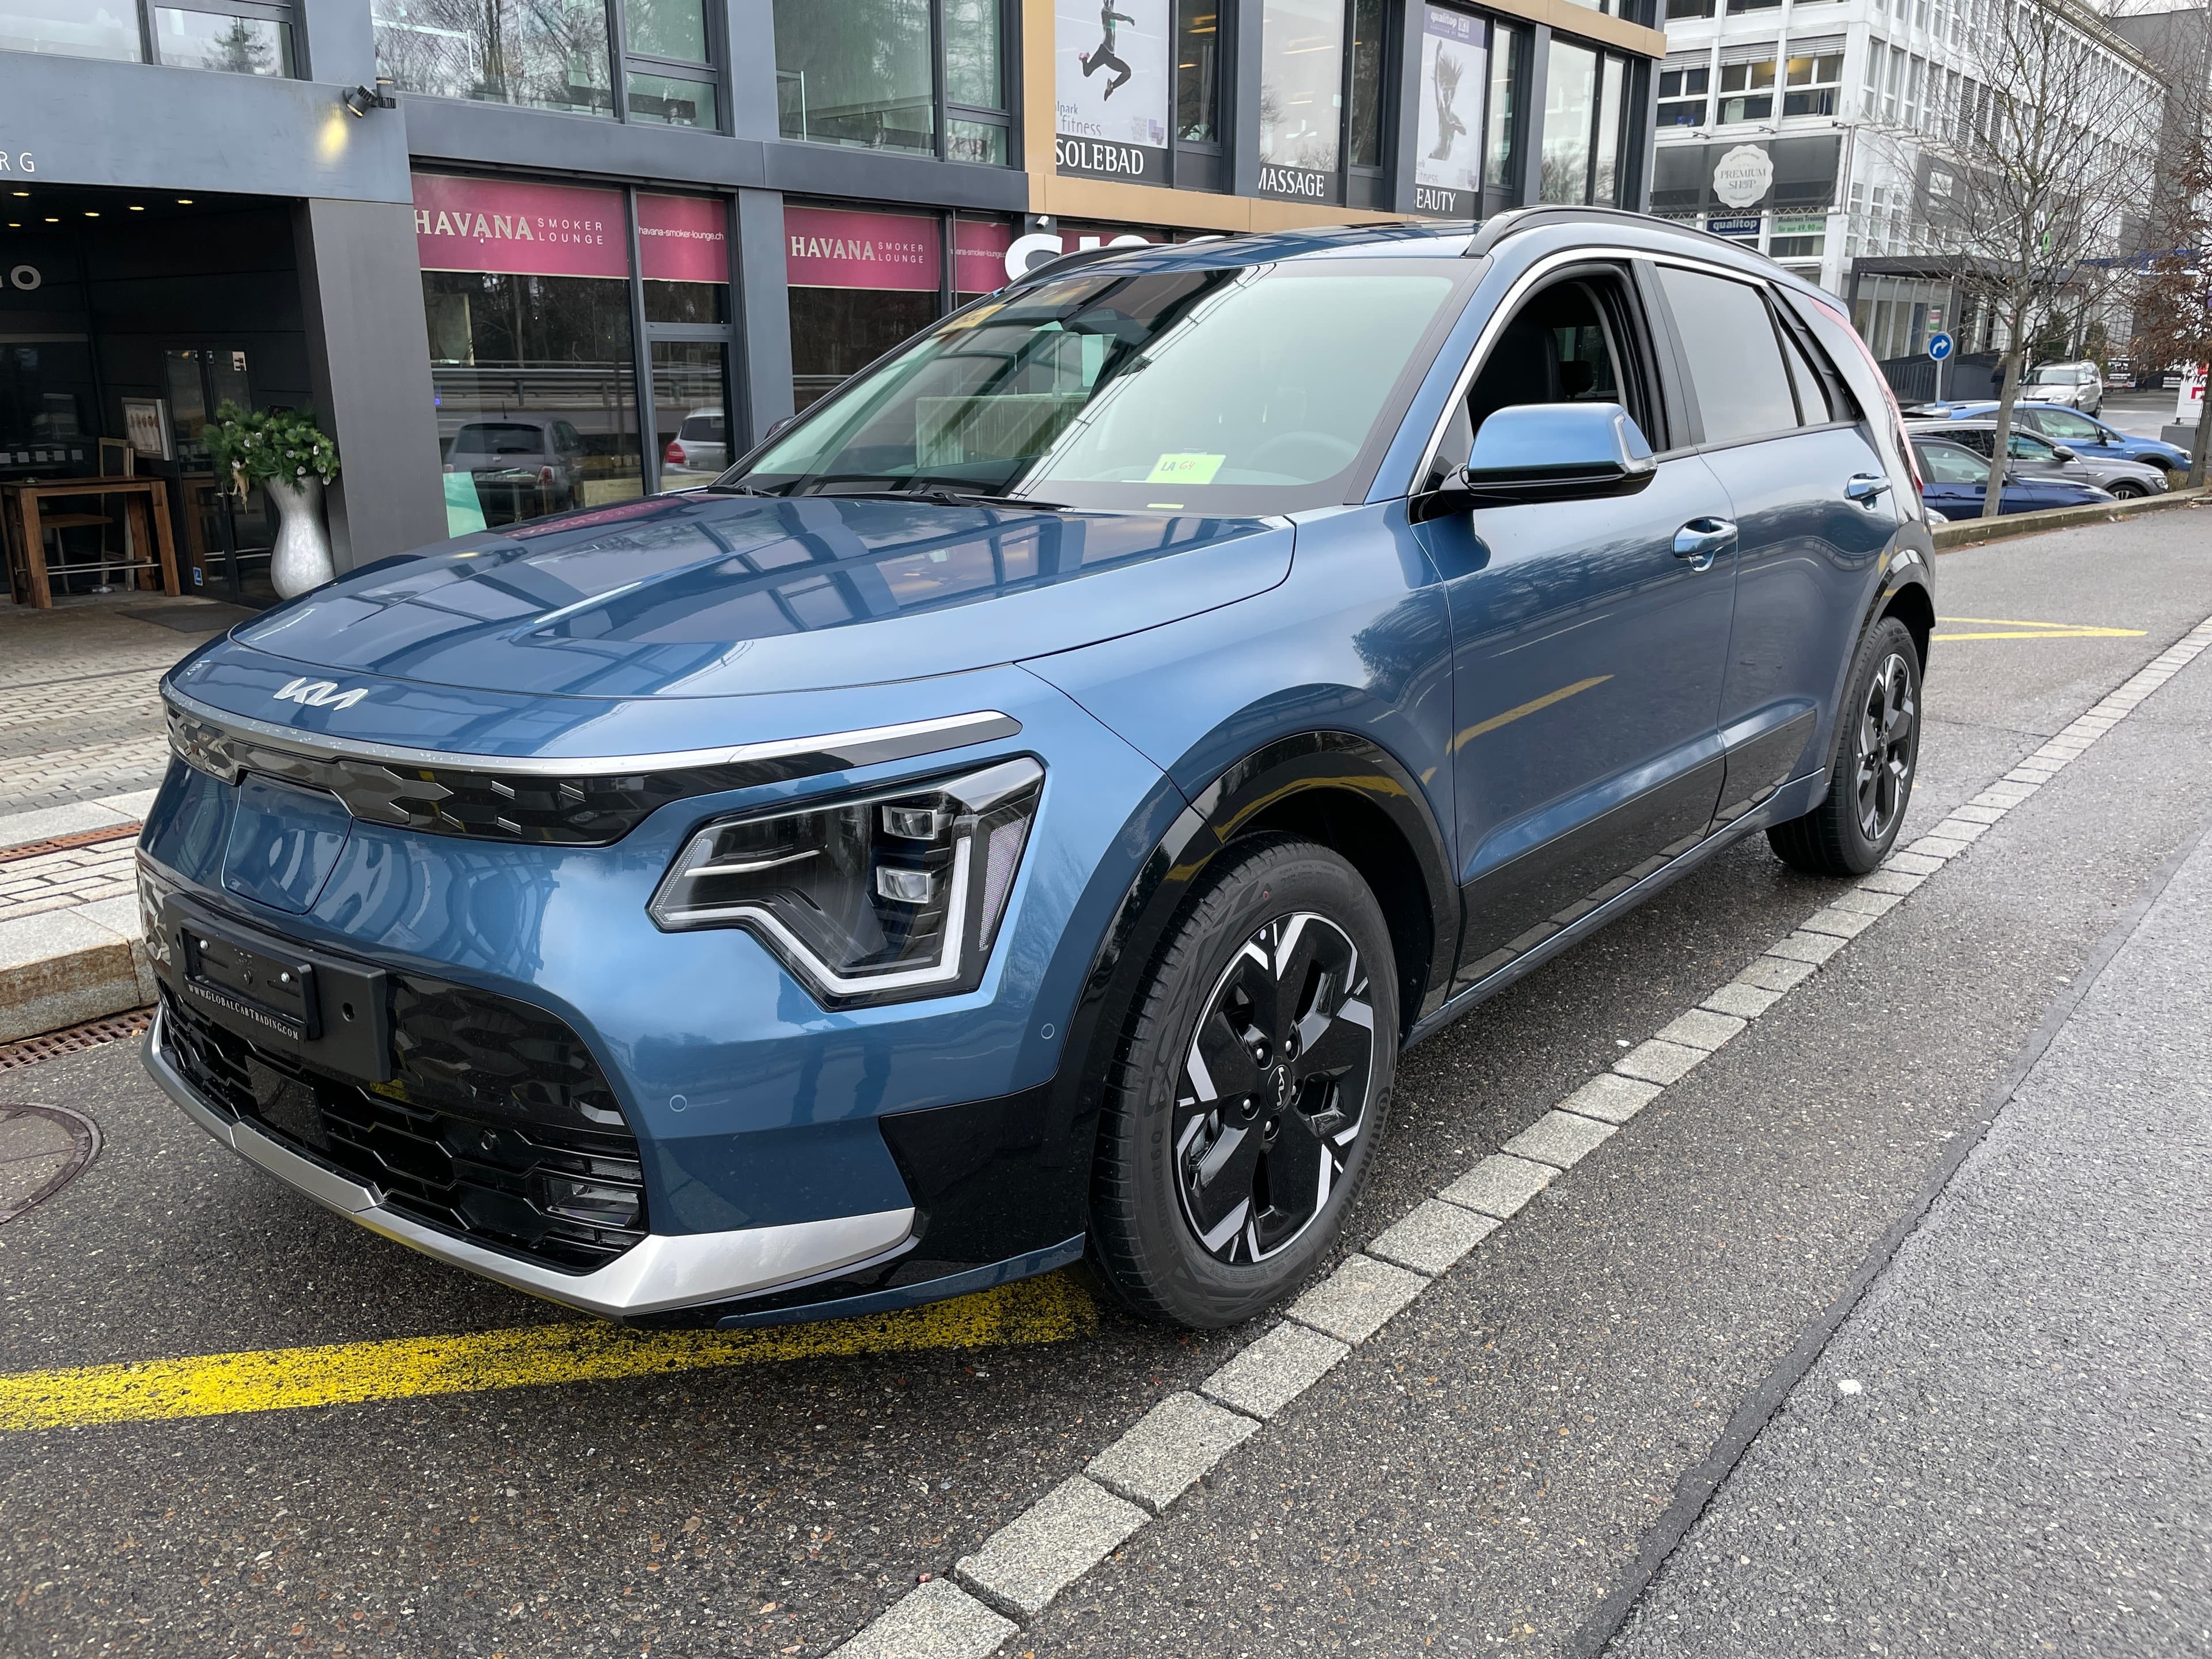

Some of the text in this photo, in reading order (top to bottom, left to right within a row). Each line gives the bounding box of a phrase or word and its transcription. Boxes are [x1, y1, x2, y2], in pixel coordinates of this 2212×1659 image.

[1430, 12, 1457, 28] qualitop
[1055, 100, 1078, 116] lpark
[1062, 115, 1101, 137] fitness
[1055, 138, 1144, 175] SOLEBAD
[1720, 168, 1766, 179] PREMIUM
[1414, 187, 1456, 212] EAUTY
[414, 209, 603, 241] HAVANA SMOKER
[1713, 219, 1757, 229] qualitop
[539, 232, 603, 245] LOUNGE
[638, 225, 724, 242] havana-smoker-lounge.ch
[790, 236, 923, 261] HAVANA SMOKER
[878, 253, 924, 264] LOUNGE
[1160, 461, 1176, 471] LA
